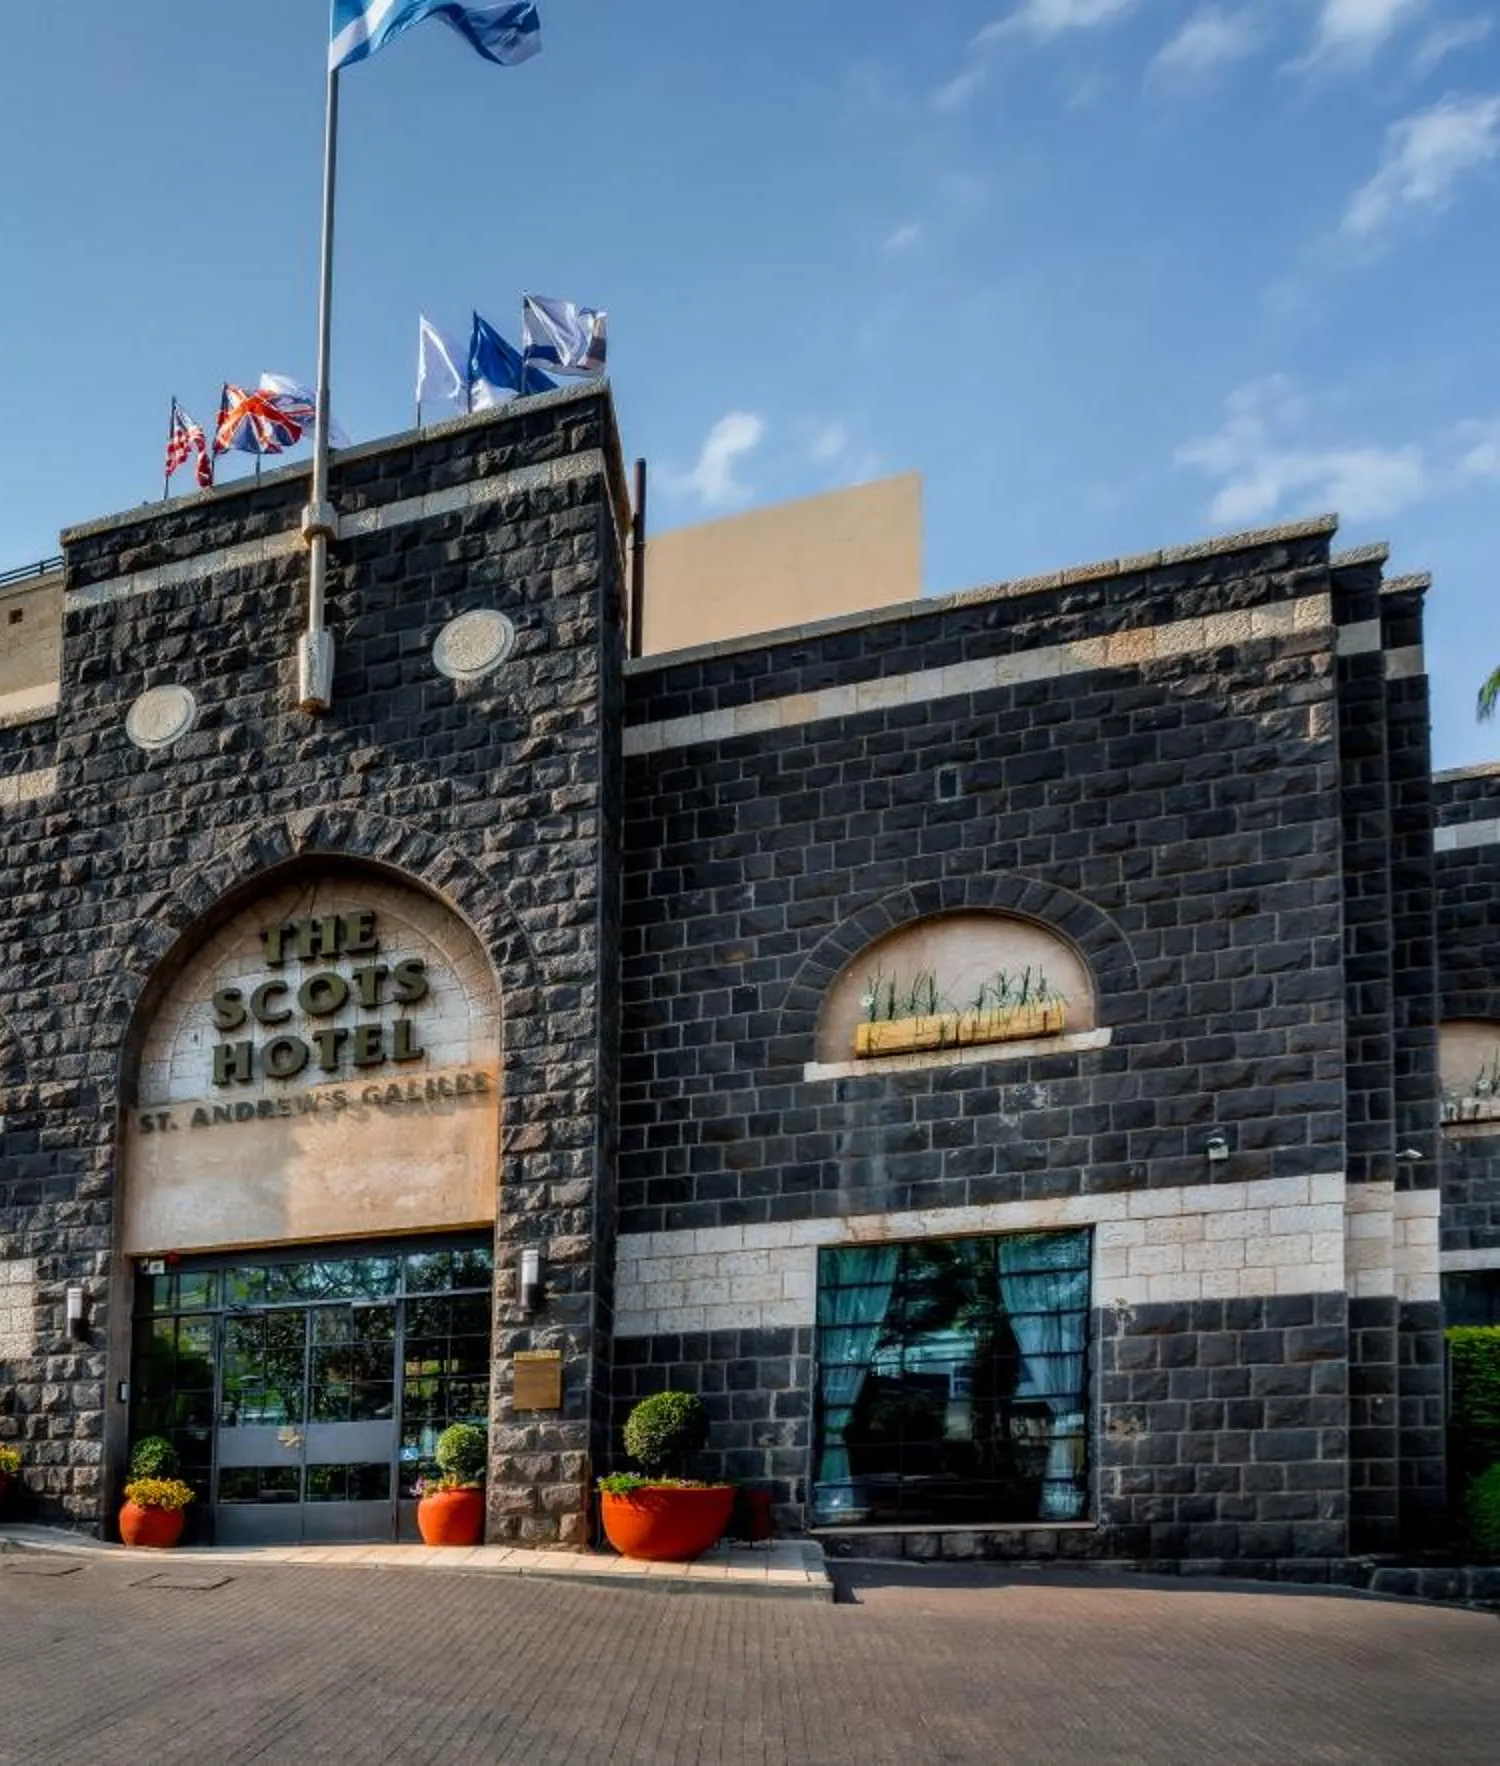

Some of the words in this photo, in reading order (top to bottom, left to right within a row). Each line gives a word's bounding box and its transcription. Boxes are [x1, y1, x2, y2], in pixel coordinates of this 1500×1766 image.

[260, 910, 380, 967] THE
[211, 957, 430, 1031] SCOTS
[212, 1019, 425, 1087] HOTEL
[139, 1111, 179, 1134] ST.
[190, 1089, 348, 1128] ANDREW'S
[361, 1071, 490, 1106] GALILEE
